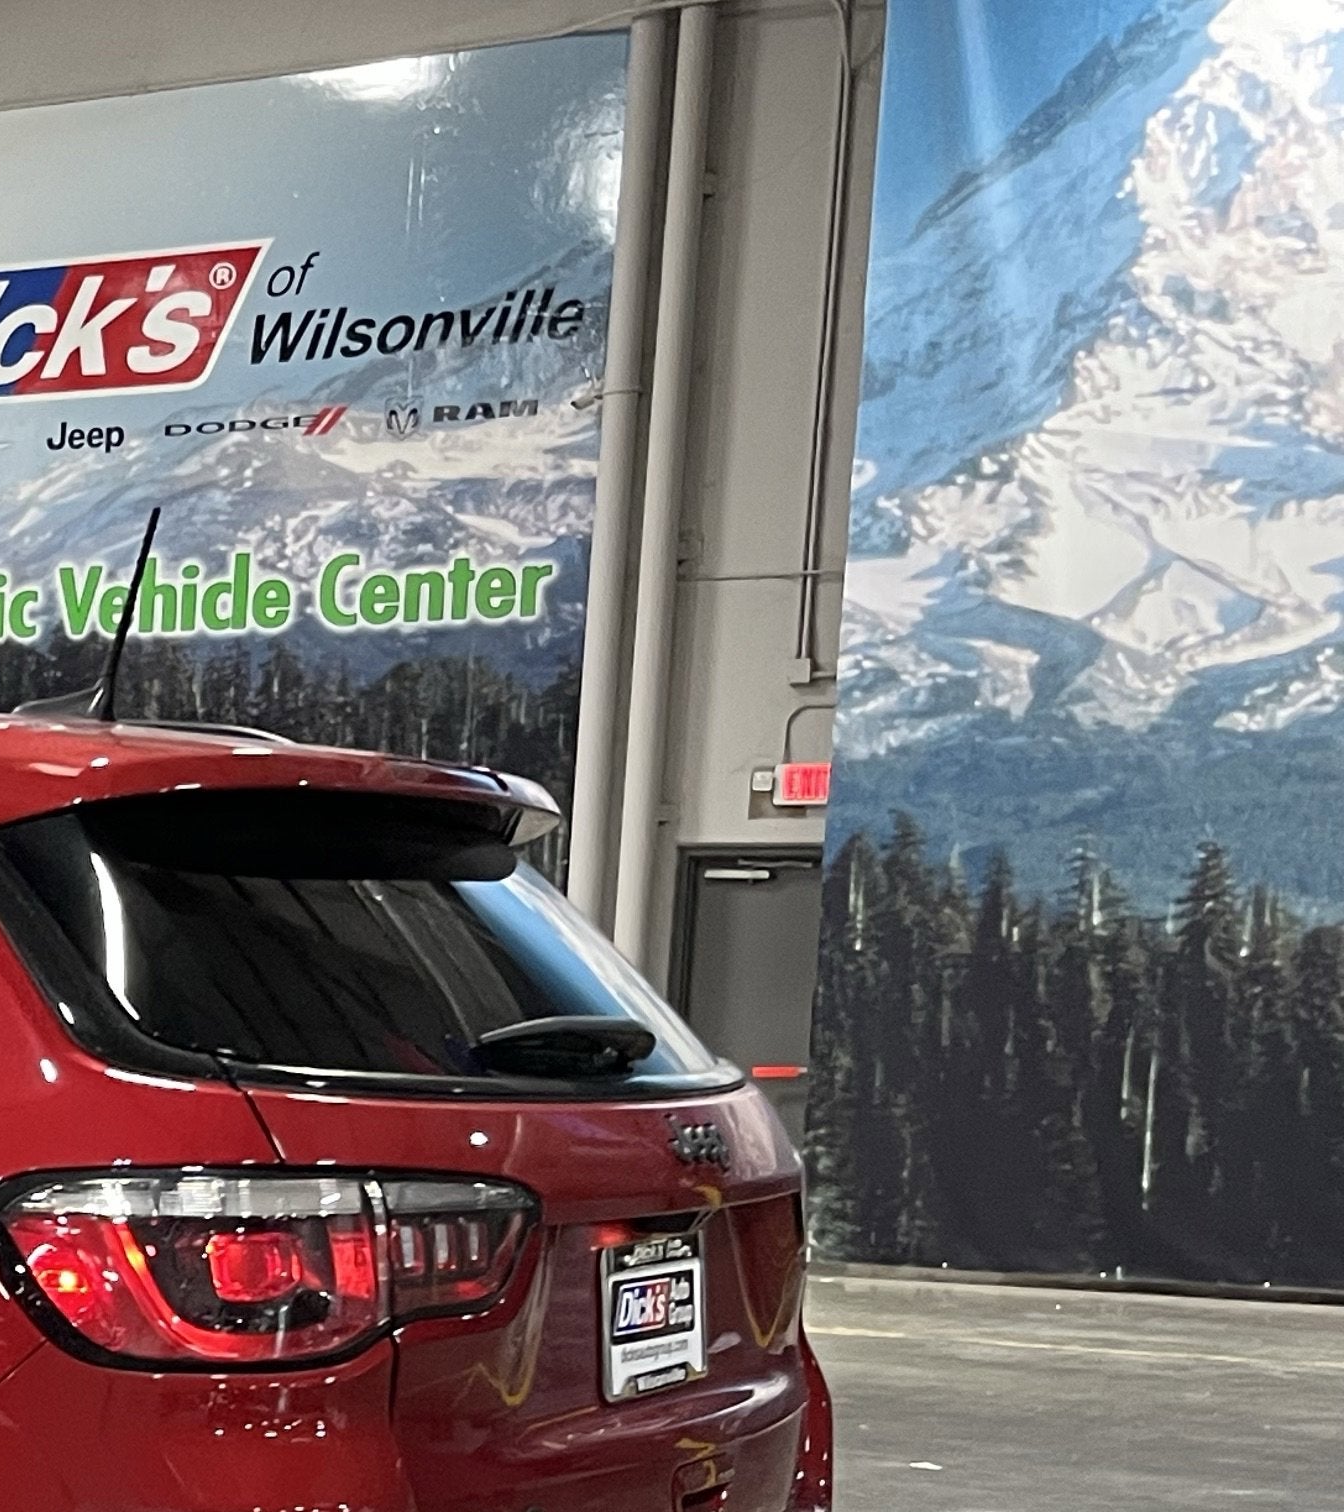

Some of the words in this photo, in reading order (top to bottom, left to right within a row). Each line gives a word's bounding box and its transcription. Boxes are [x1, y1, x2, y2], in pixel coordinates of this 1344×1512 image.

[266, 251, 320, 298] of
[250, 287, 585, 365] Wilsonville
[163, 413, 318, 438] DODGE
[433, 400, 539, 424] RAM
[46, 421, 125, 453] Jeep
[59, 553, 291, 636] Vehicle
[319, 553, 553, 627] Center
[618, 1284, 667, 1329] Dick's
